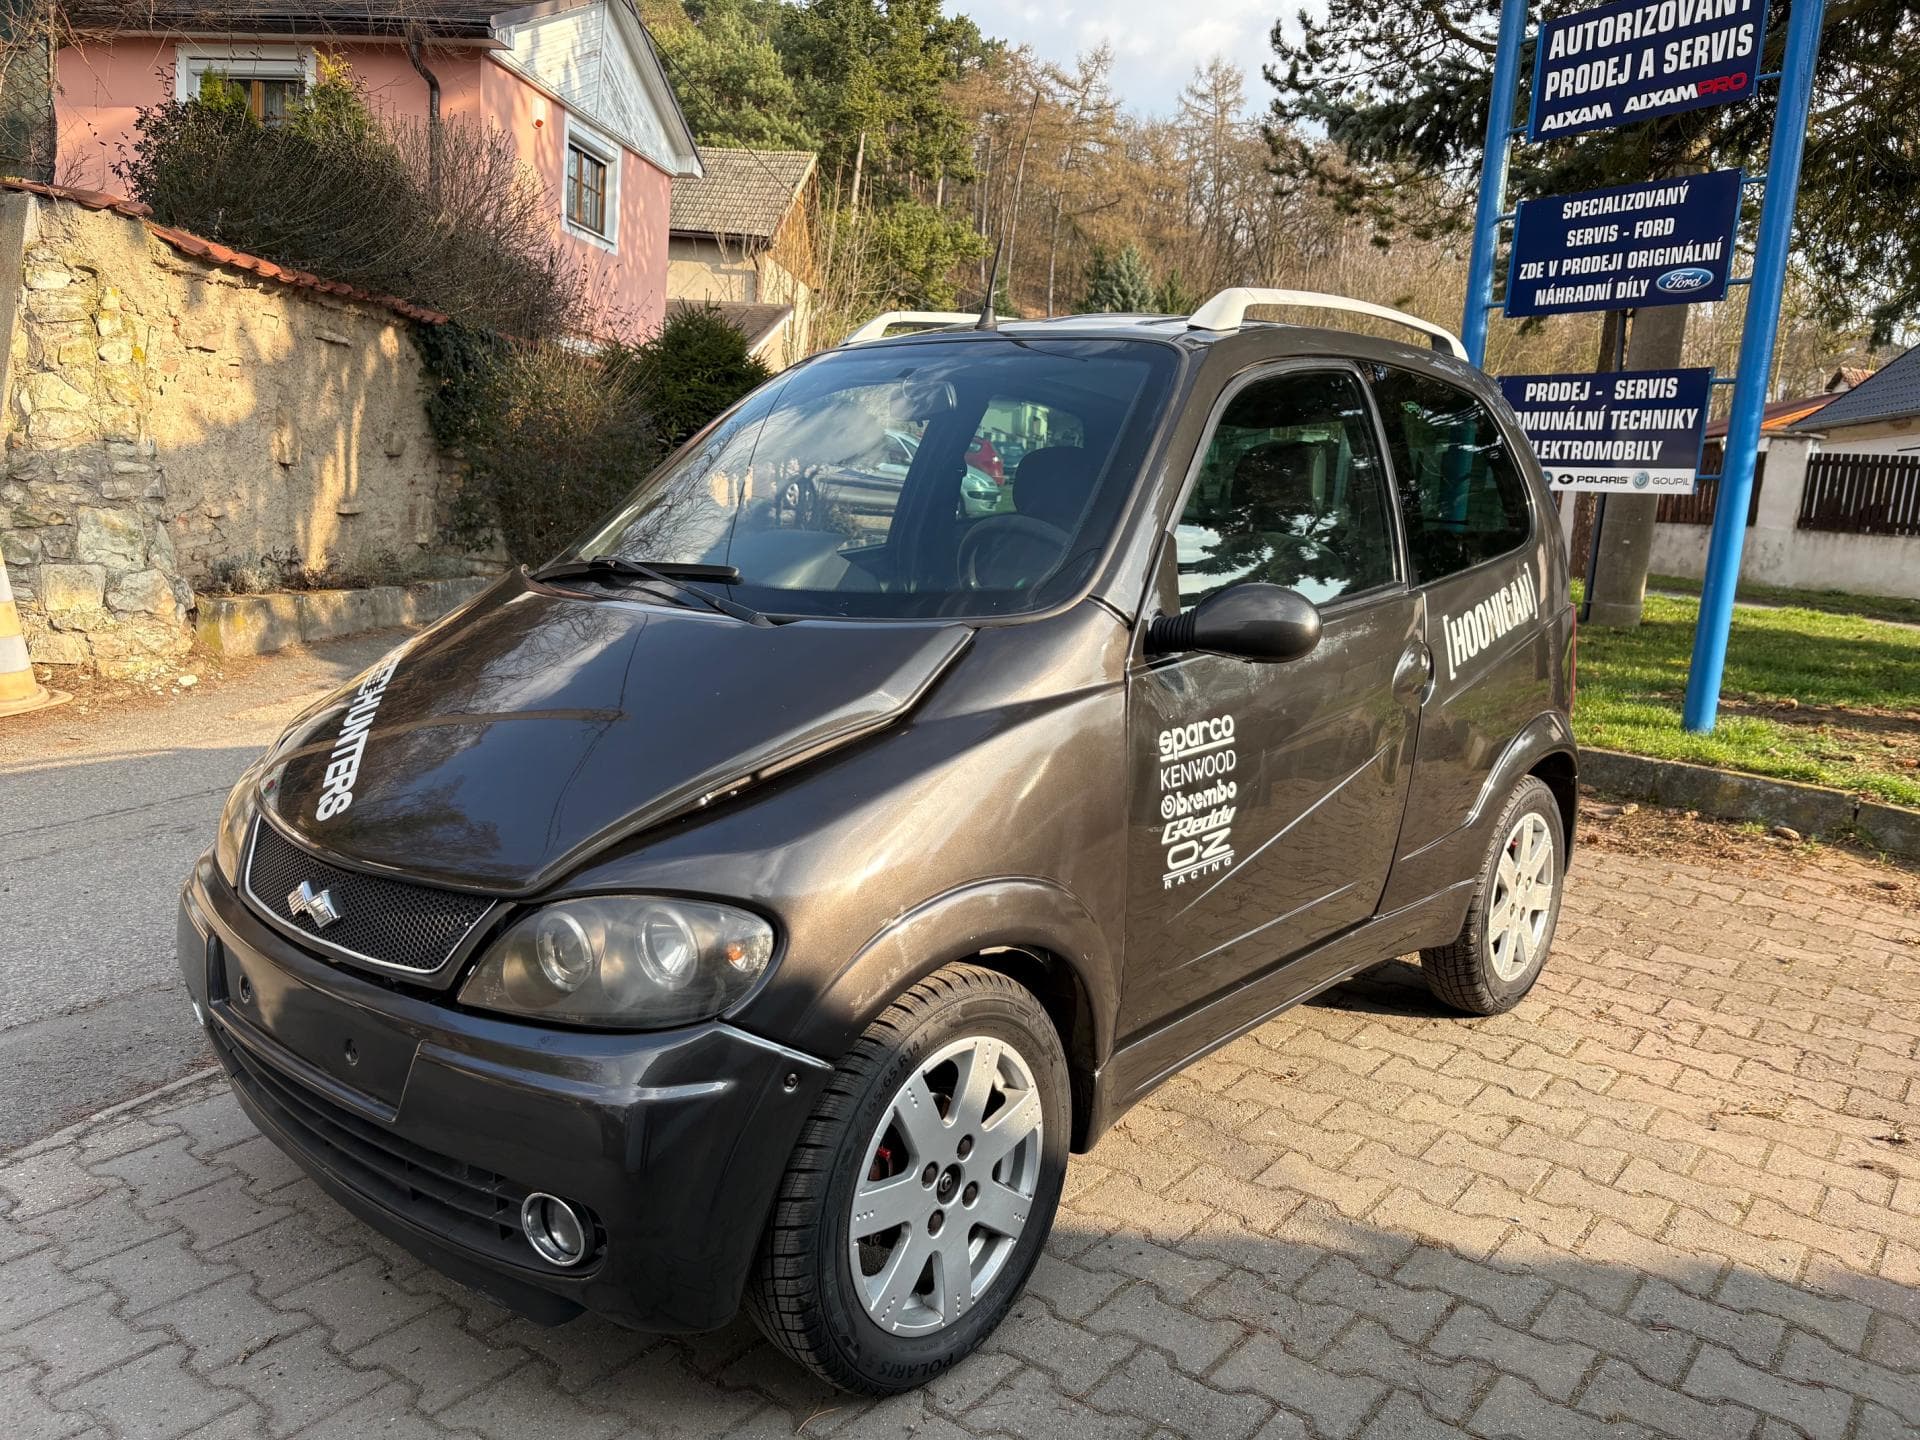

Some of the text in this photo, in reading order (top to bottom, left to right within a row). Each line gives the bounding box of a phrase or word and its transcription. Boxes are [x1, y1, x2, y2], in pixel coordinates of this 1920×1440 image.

[1544, 23, 1754, 101] PRODEJ A SERVIS
[1541, 102, 1613, 132] AIXAM
[1562, 180, 1690, 220] SPECIALIZOVANÝ
[1566, 224, 1619, 247] SERVIS
[1634, 217, 1676, 240] FORD
[1519, 236, 1724, 280] ZDE V PRODEJI ORIGINÁLNÍ
[1534, 275, 1650, 306] NÁHRADNÍ DÍLY
[1665, 271, 1702, 290] Ford
[1524, 381, 1591, 402] PRODEJ
[1614, 377, 1679, 400] SERVIS
[1610, 408, 1699, 431] TECHNIKY
[1529, 439, 1664, 461] LEKTROMOBILY
[1576, 475, 1690, 486] POLARIS GOUPIL
[1159, 714, 1235, 760] sparco
[1160, 750, 1237, 791] KENWOOD
[1176, 779, 1238, 816] brembo
[1164, 856, 1232, 889] RACING
